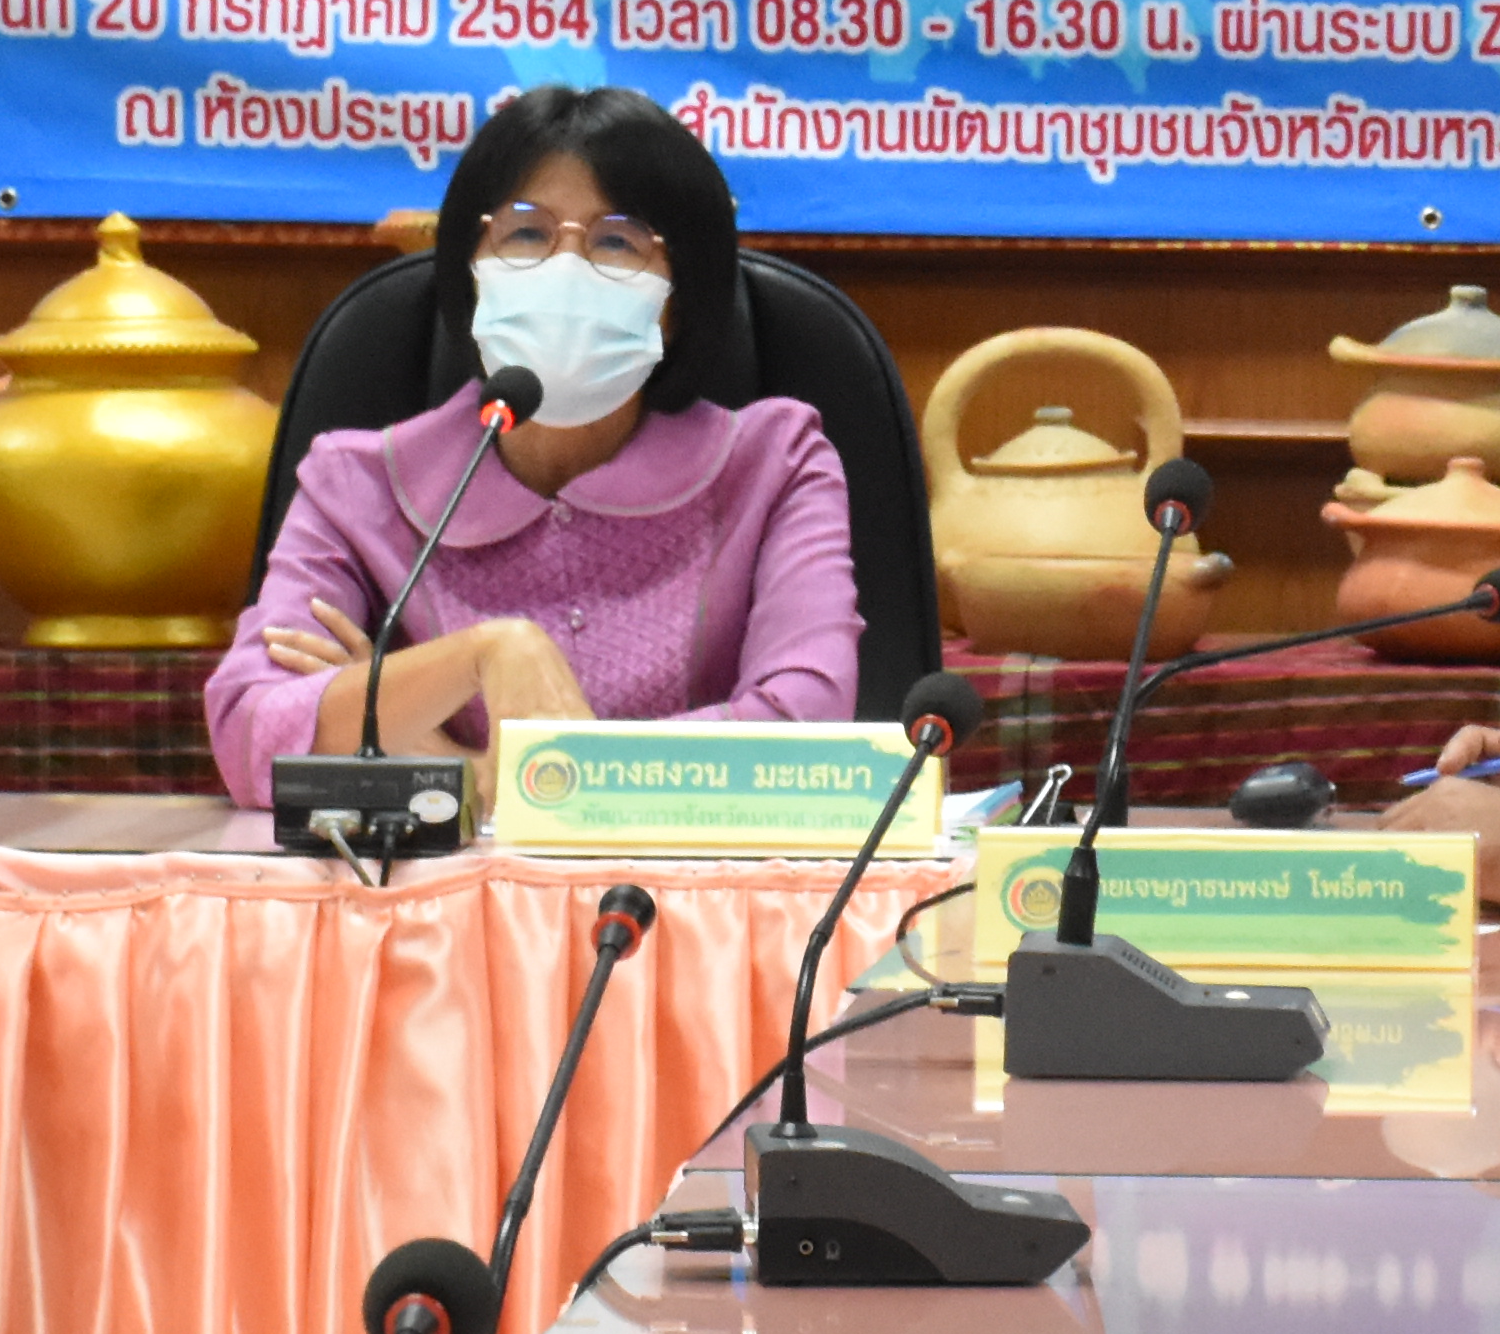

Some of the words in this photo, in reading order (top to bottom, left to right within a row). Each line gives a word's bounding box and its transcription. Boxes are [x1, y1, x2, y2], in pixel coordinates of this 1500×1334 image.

[1146, 8, 1194, 52] น.
[125, 91, 176, 138] ณ
[203, 80, 469, 162] ห้องประชุม
[581, 759, 729, 789] นางสงวน
[754, 762, 873, 791] มะเสนา
[1098, 872, 1291, 908] ายเจษฎาธนพงษ์
